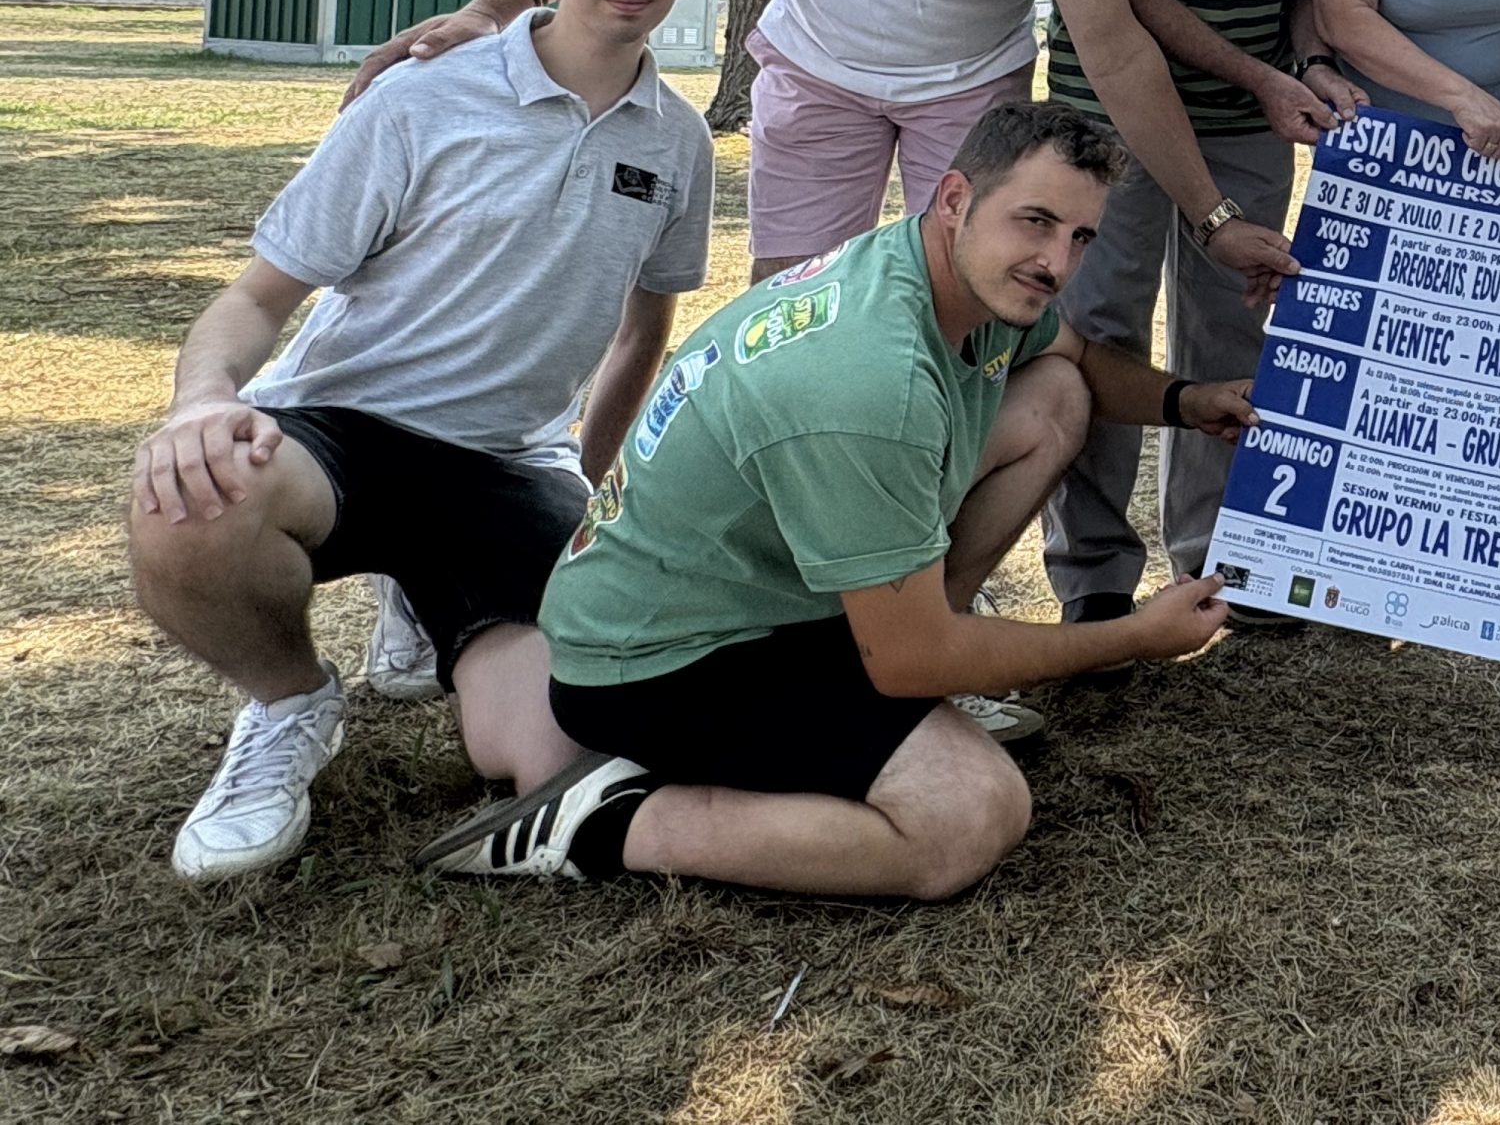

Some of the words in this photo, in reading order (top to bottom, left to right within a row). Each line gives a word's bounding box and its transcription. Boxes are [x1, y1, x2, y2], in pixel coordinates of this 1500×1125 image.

[1325, 112, 1396, 162] FESTA
[1404, 129, 1455, 175] DOS
[1348, 158, 1380, 177] 60
[1318, 181, 1337, 205] 30
[1340, 187, 1352, 209] E
[1355, 191, 1371, 214] 31
[1373, 196, 1395, 220] DE
[1398, 203, 1442, 232] XULLO,
[1458, 215, 1469, 236] E
[1472, 218, 1483, 238] 2
[1316, 217, 1370, 248] XOVES
[1390, 233, 1399, 246] A
[1400, 238, 1431, 252] partir
[1434, 243, 1452, 256] das
[1323, 243, 1349, 270] 30
[1297, 281, 1362, 311] VENRES
[1380, 298, 1390, 309] A
[1393, 304, 1427, 318] partir
[1431, 311, 1452, 323] das
[1312, 307, 1334, 332] 31
[1372, 314, 1454, 366] EVENTEC
[1273, 344, 1346, 381] SÁBADO
[1360, 388, 1370, 400] A
[1374, 395, 1412, 409] partir
[1417, 402, 1438, 416] das
[1353, 404, 1438, 455] ALIANZA
[1245, 426, 1333, 467] DOMINGO
[1431, 470, 1441, 479] DE
[1264, 465, 1296, 516] 2
[1332, 497, 1412, 546] GRUPO
[1420, 518, 1449, 557] LA
[1345, 604, 1369, 616] LUGO
